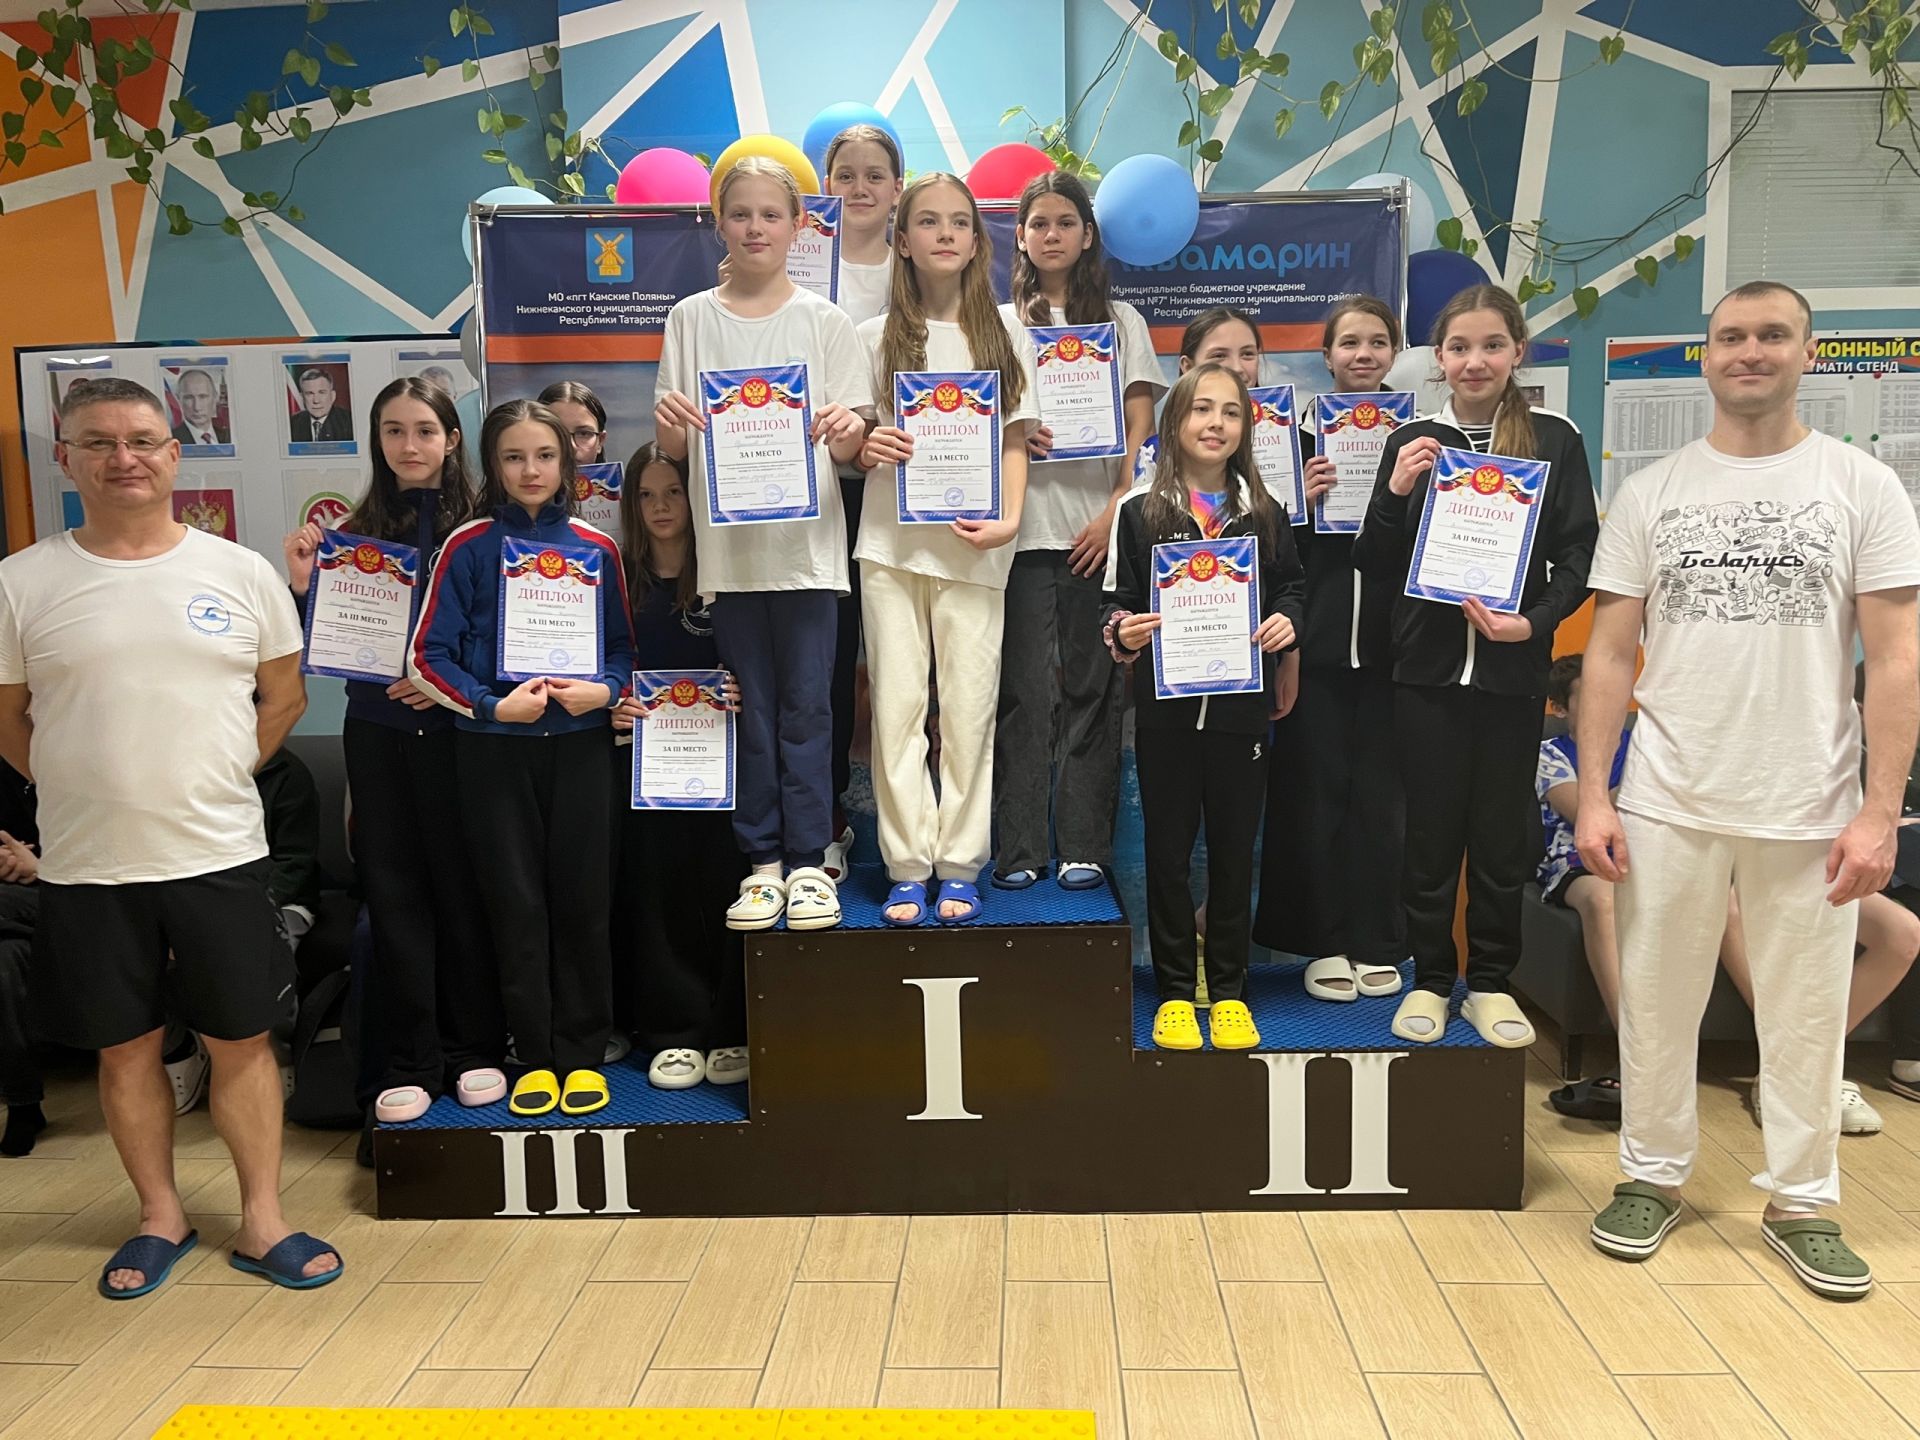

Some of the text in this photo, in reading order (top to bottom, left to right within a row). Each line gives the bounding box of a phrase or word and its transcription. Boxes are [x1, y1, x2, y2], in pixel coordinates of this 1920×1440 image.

[1110, 282, 1306, 296] Муниципальное бюджетное учреждение
[548, 292, 564, 302] МО
[589, 292, 630, 301] Камские
[632, 292, 676, 301] Поляны»
[1169, 295, 1245, 306] Нижнекамского
[1247, 293, 1326, 305] муниципального
[516, 305, 592, 314] Нижнекамского
[559, 315, 617, 326] Республики
[1856, 360, 1899, 373] СТЕНД
[1043, 370, 1100, 385] ДИПЛОМ
[724, 418, 790, 434] ДИПЛОМ
[916, 424, 979, 437] ДИПЛОМ
[1336, 440, 1384, 453] ДИПЛО
[739, 451, 749, 459] ЗА
[755, 449, 782, 458] МЕСТО
[1445, 502, 1516, 523] ДИПЛОМ
[1470, 536, 1498, 547] МЕСТО
[1679, 550, 1804, 577] Беларусь
[330, 580, 400, 602] ДИПЛОМ
[518, 587, 584, 604] ДИПЛОМ
[1171, 592, 1236, 609] ДИПЛОМ
[337, 612, 388, 626] ЗА III МЕСТО
[538, 618, 547, 626] III
[548, 619, 576, 628] МЕСТО
[1183, 625, 1193, 633] ЗА
[1201, 624, 1228, 632] МЕСТО
[653, 718, 715, 730] ДИПЛОМ
[902, 976, 983, 1122] I
[1248, 1052, 1411, 1197] II
[490, 1128, 642, 1218] III
